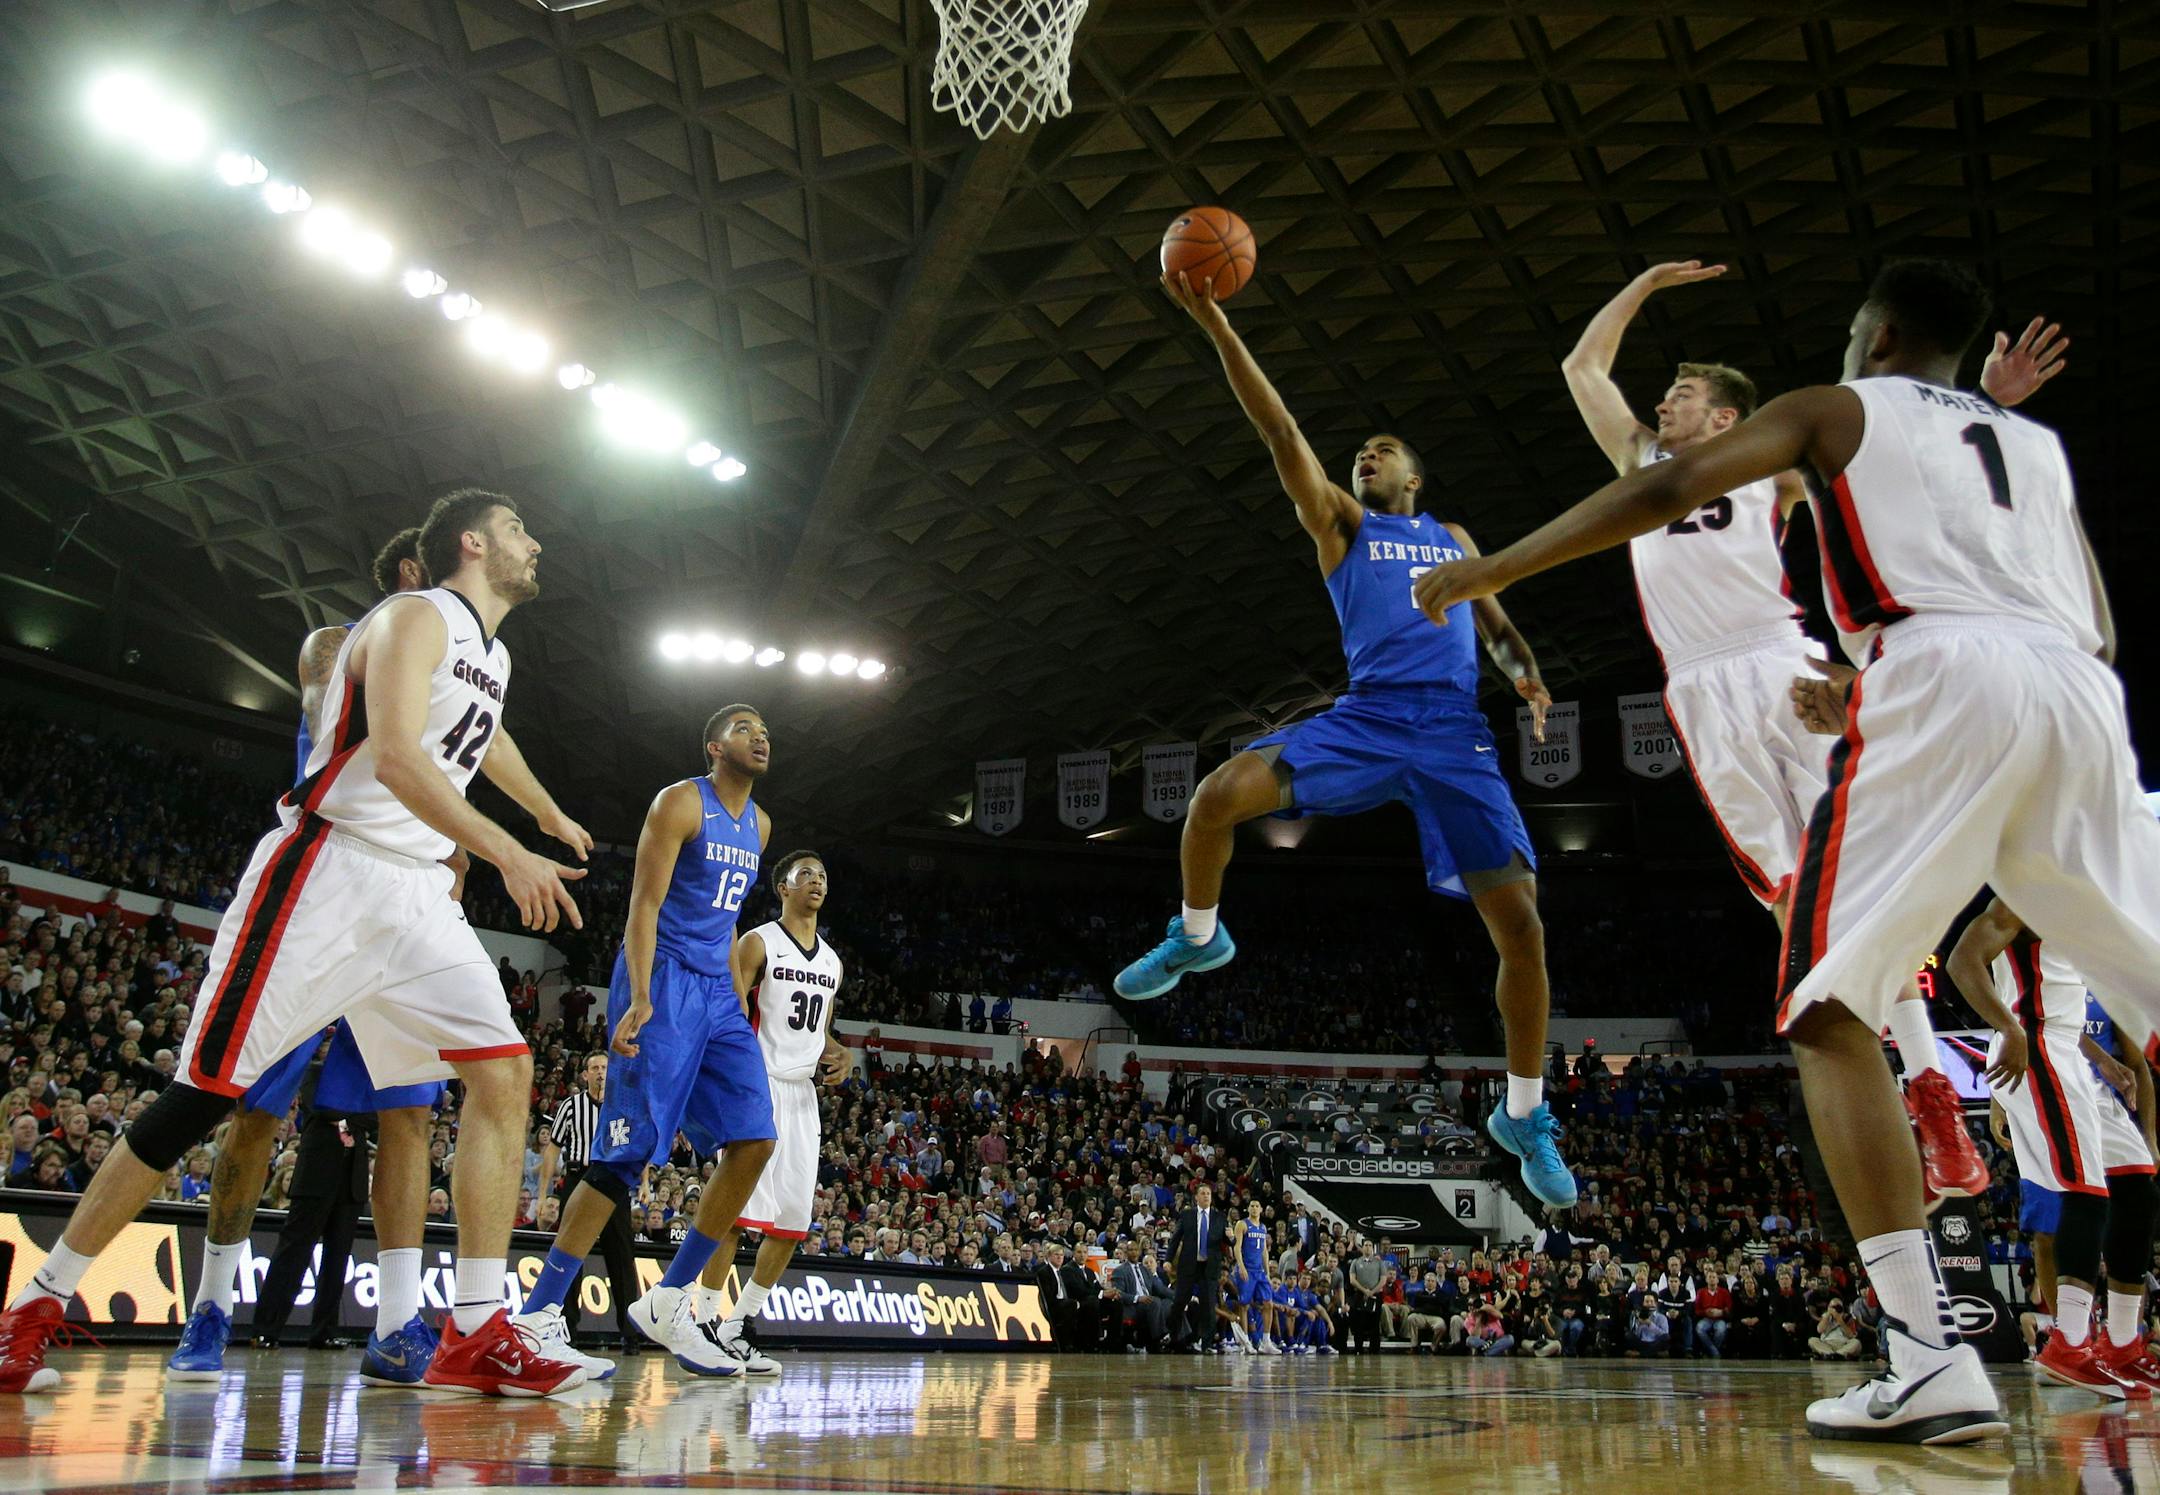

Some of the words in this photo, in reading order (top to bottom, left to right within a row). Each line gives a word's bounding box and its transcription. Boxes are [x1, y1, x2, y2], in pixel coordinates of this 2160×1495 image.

[1960, 422, 2013, 512] 1
[441, 701, 494, 771] 42
[1634, 737, 1673, 755] 2007
[1531, 748, 1570, 766] 2006
[1066, 793, 1099, 808] 1989
[1152, 785, 1186, 801] 1993
[984, 800, 1014, 815] 1987
[712, 869, 748, 912] 12
[773, 967, 836, 992] GEORGIA
[788, 990, 824, 1033] 30
[1296, 1155, 1487, 1177] georgiadogs.com
[1459, 1198, 1472, 1217] 2
[1256, 1238, 1261, 1249] 1
[1940, 1257, 1980, 1267] KENDA
[762, 1275, 986, 1336] theParkingSpot
